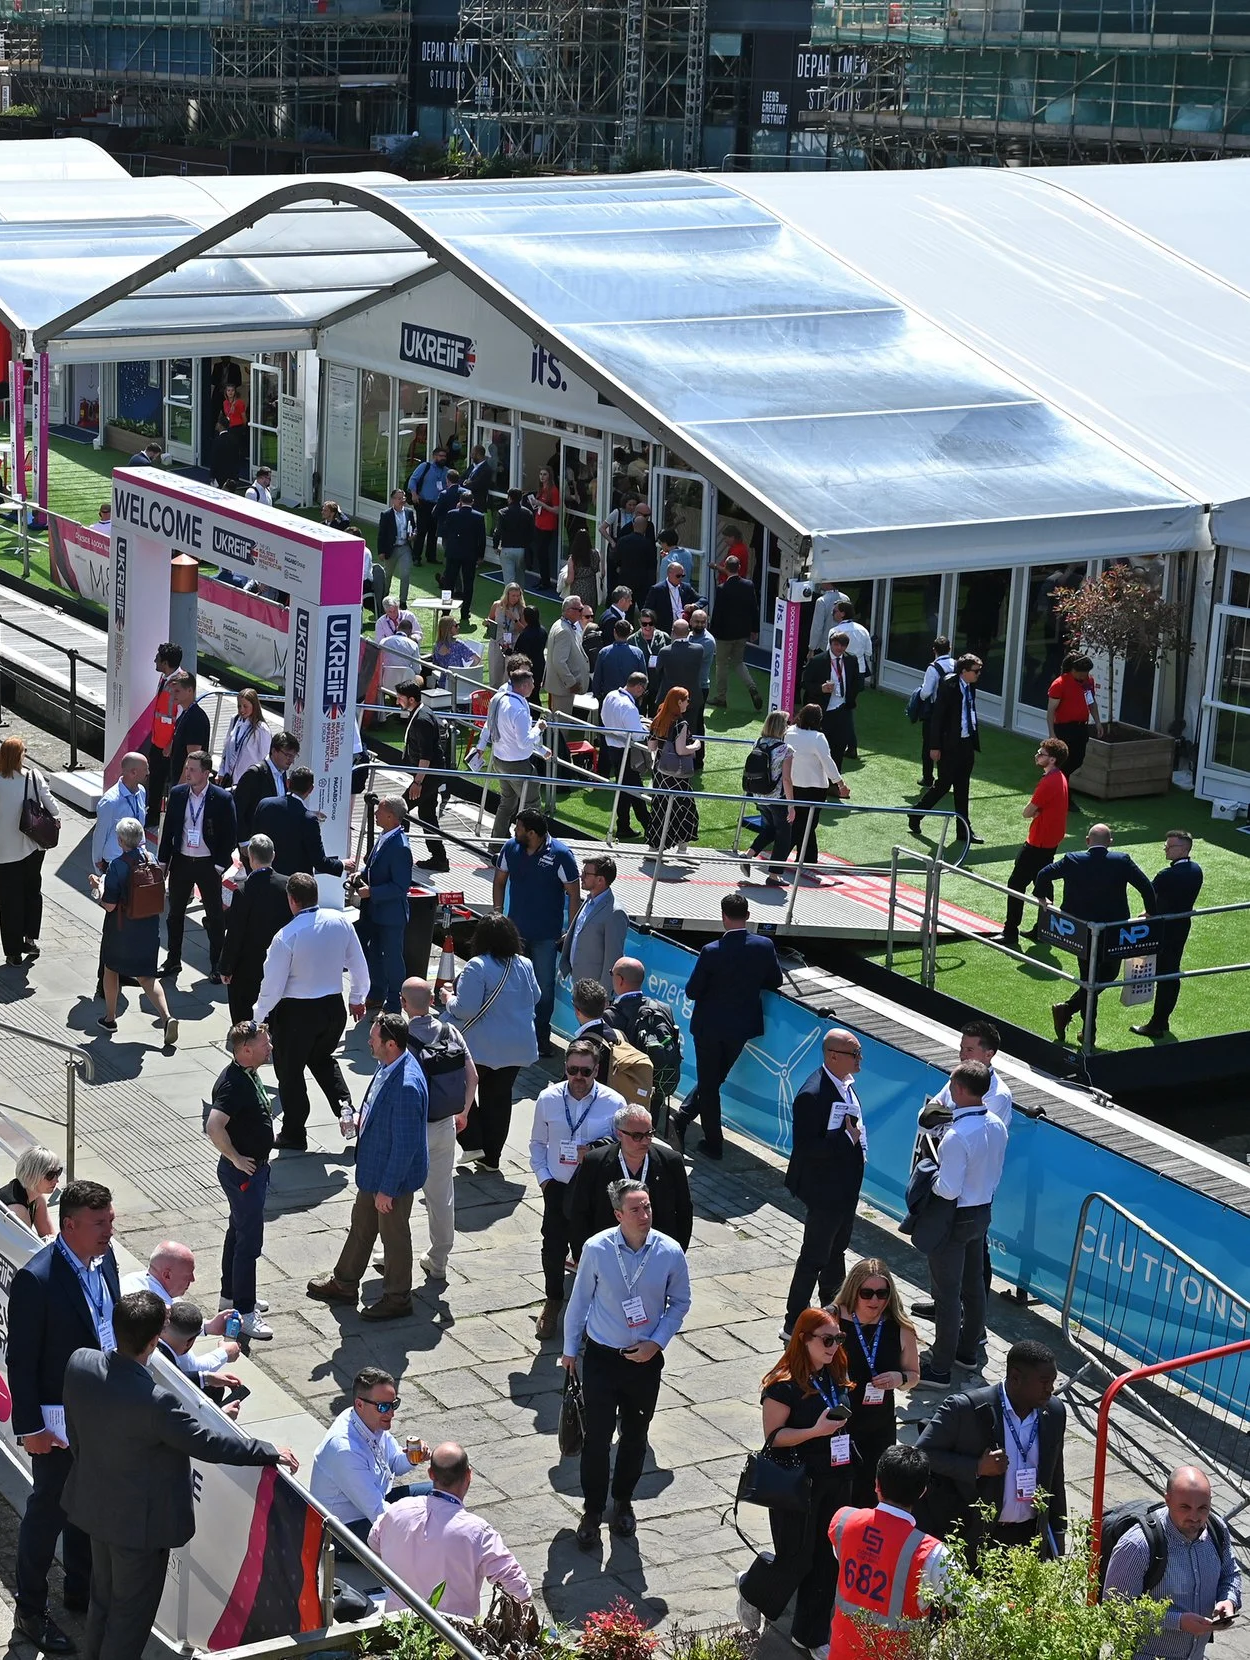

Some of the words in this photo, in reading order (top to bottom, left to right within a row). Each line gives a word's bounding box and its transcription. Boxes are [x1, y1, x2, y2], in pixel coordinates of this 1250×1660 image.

[762, 90, 780, 102] LEEDS
[762, 103, 788, 114] CREATIVE
[761, 114, 787, 125] DISTRICT
[115, 487, 203, 549] WELCOME
[327, 619, 348, 703] UKREiiF
[1041, 929, 1062, 940] NATIONAL
[1063, 937, 1084, 949] PONTOON
[1081, 1224, 1248, 1329] CLUTTONS
[845, 1558, 888, 1603] 682
